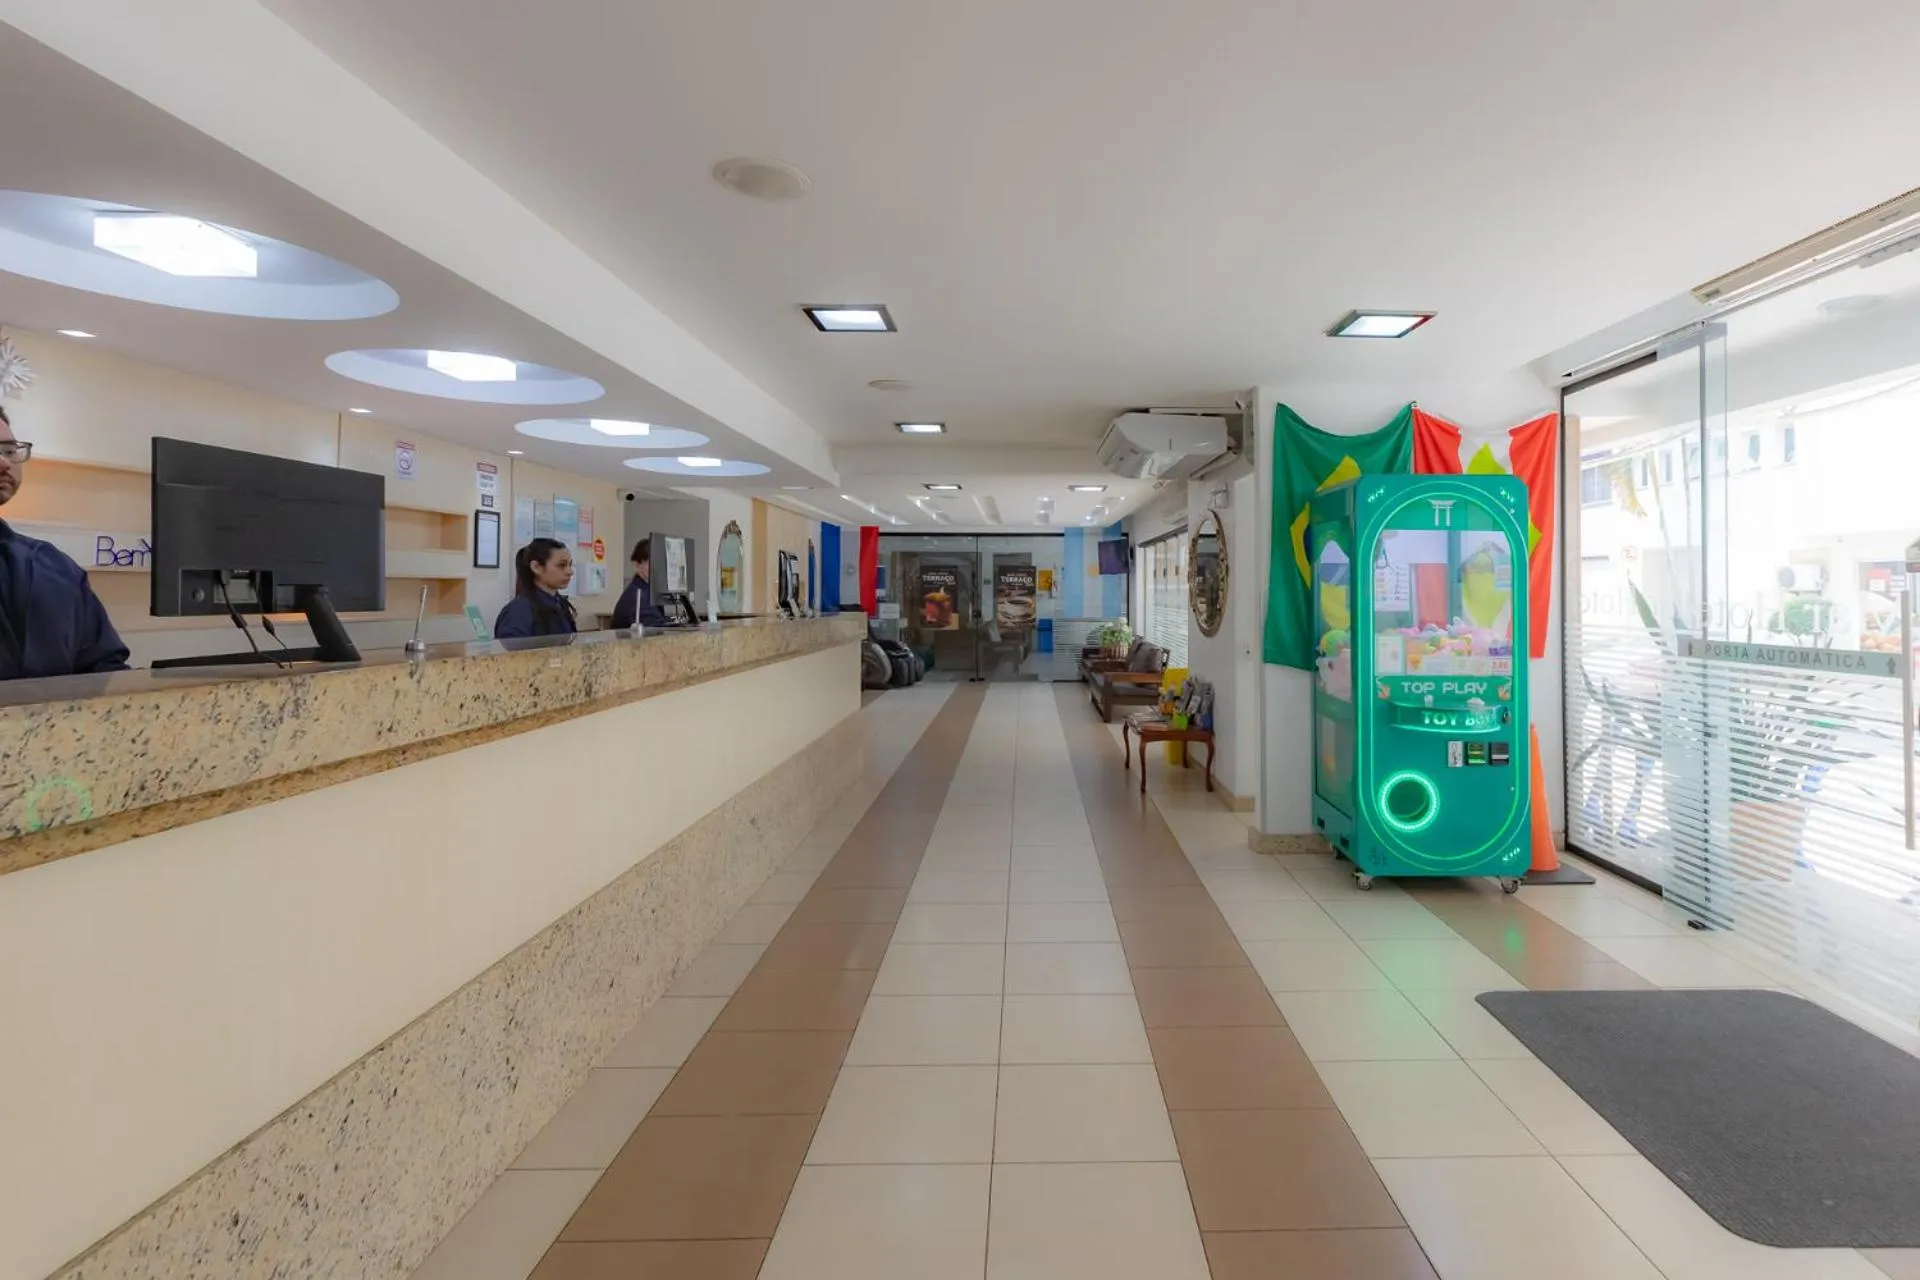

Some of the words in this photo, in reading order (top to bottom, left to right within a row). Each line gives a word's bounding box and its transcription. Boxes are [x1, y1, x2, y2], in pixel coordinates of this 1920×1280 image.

[1705, 643, 1749, 659] PORTA
[1401, 681, 1436, 694] TOP
[1442, 681, 1488, 695] PLAY
[1422, 710, 1459, 726] TOY
